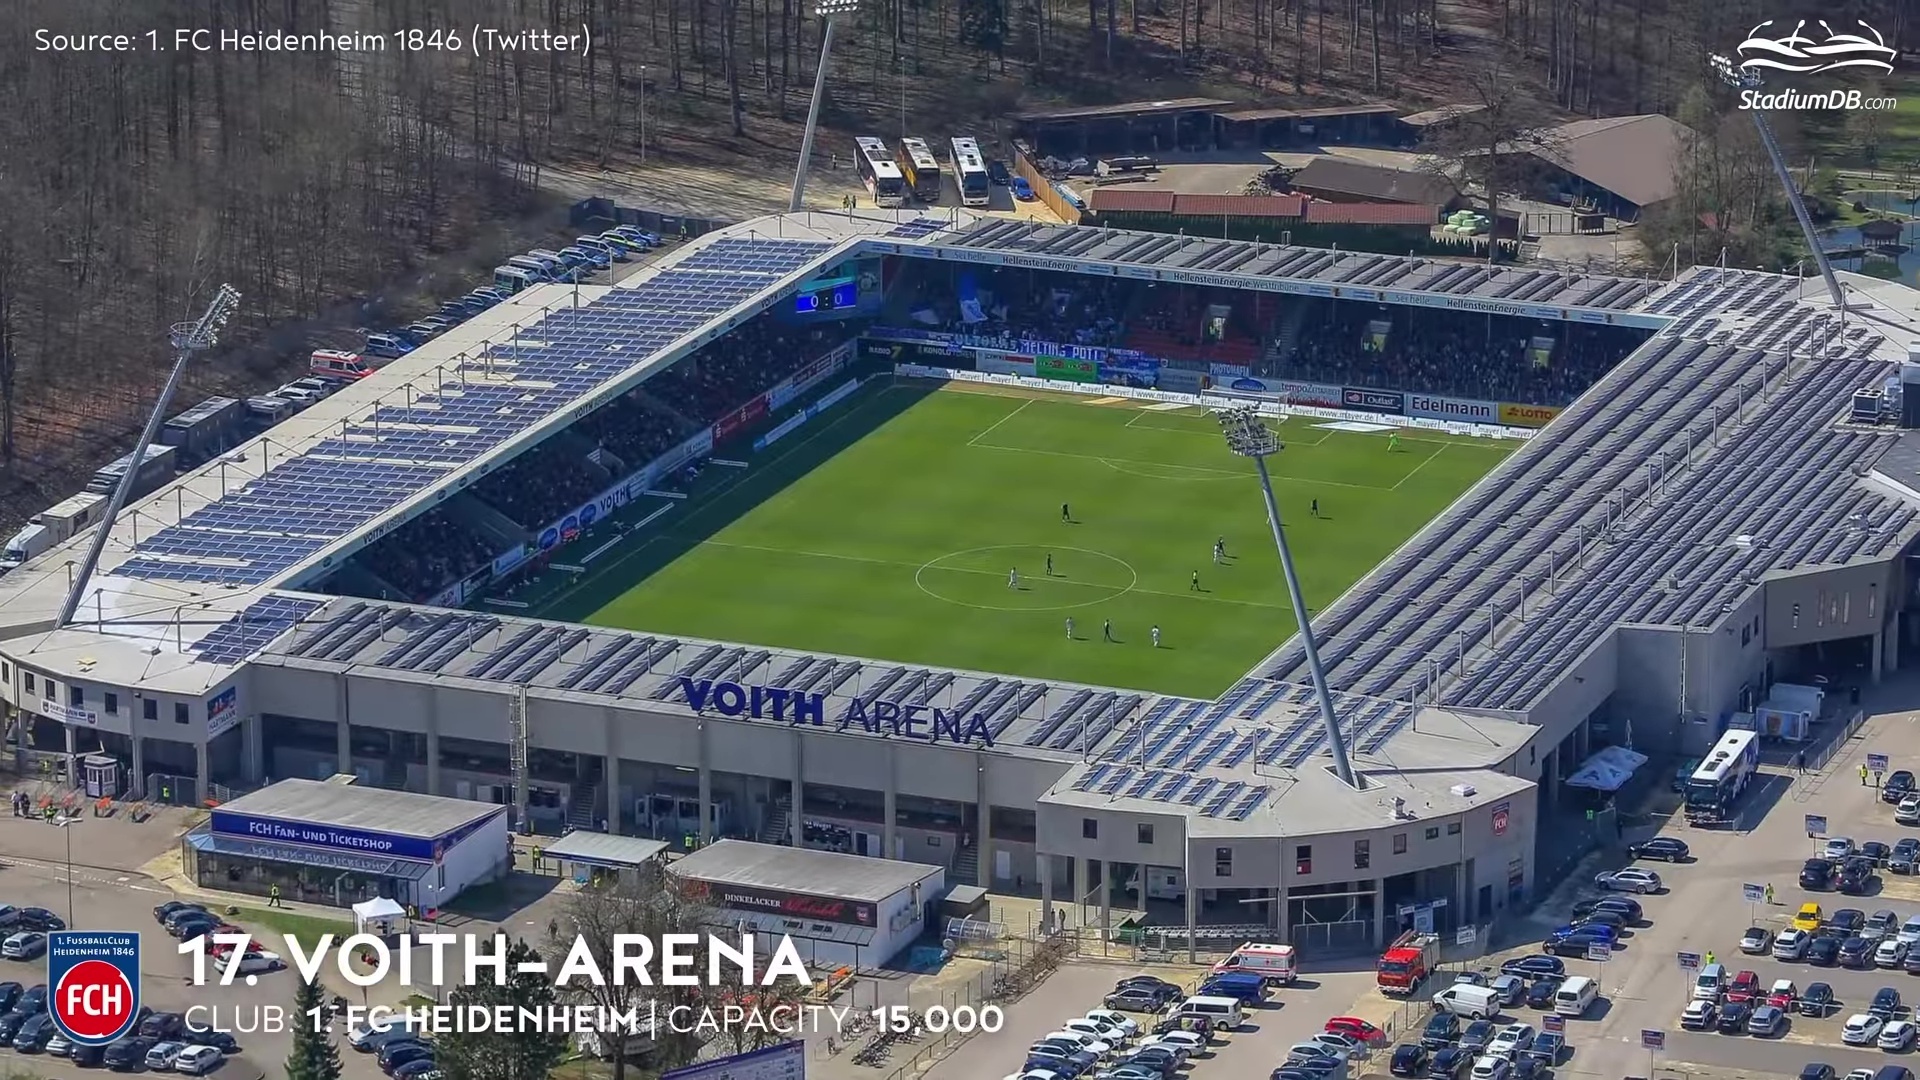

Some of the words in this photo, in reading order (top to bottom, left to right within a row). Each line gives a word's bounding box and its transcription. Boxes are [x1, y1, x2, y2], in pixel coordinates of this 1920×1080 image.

[1002, 255, 1078, 271] HellensteinEnergie
[810, 295, 819, 308] 0
[834, 293, 842, 305] 0
[1412, 396, 1491, 418] Edelmann
[1520, 407, 1552, 420] LOTTO
[1385, 416, 1406, 427] mayer
[1416, 419, 1438, 429] mayer
[1446, 422, 1469, 432] mayer
[1477, 426, 1500, 436] mayer
[1509, 429, 1531, 439] mayer
[680, 676, 824, 727] VOITH
[842, 697, 995, 748] ARENA
[250, 822, 272, 836] FCH
[724, 893, 781, 908] DINKELACKER
